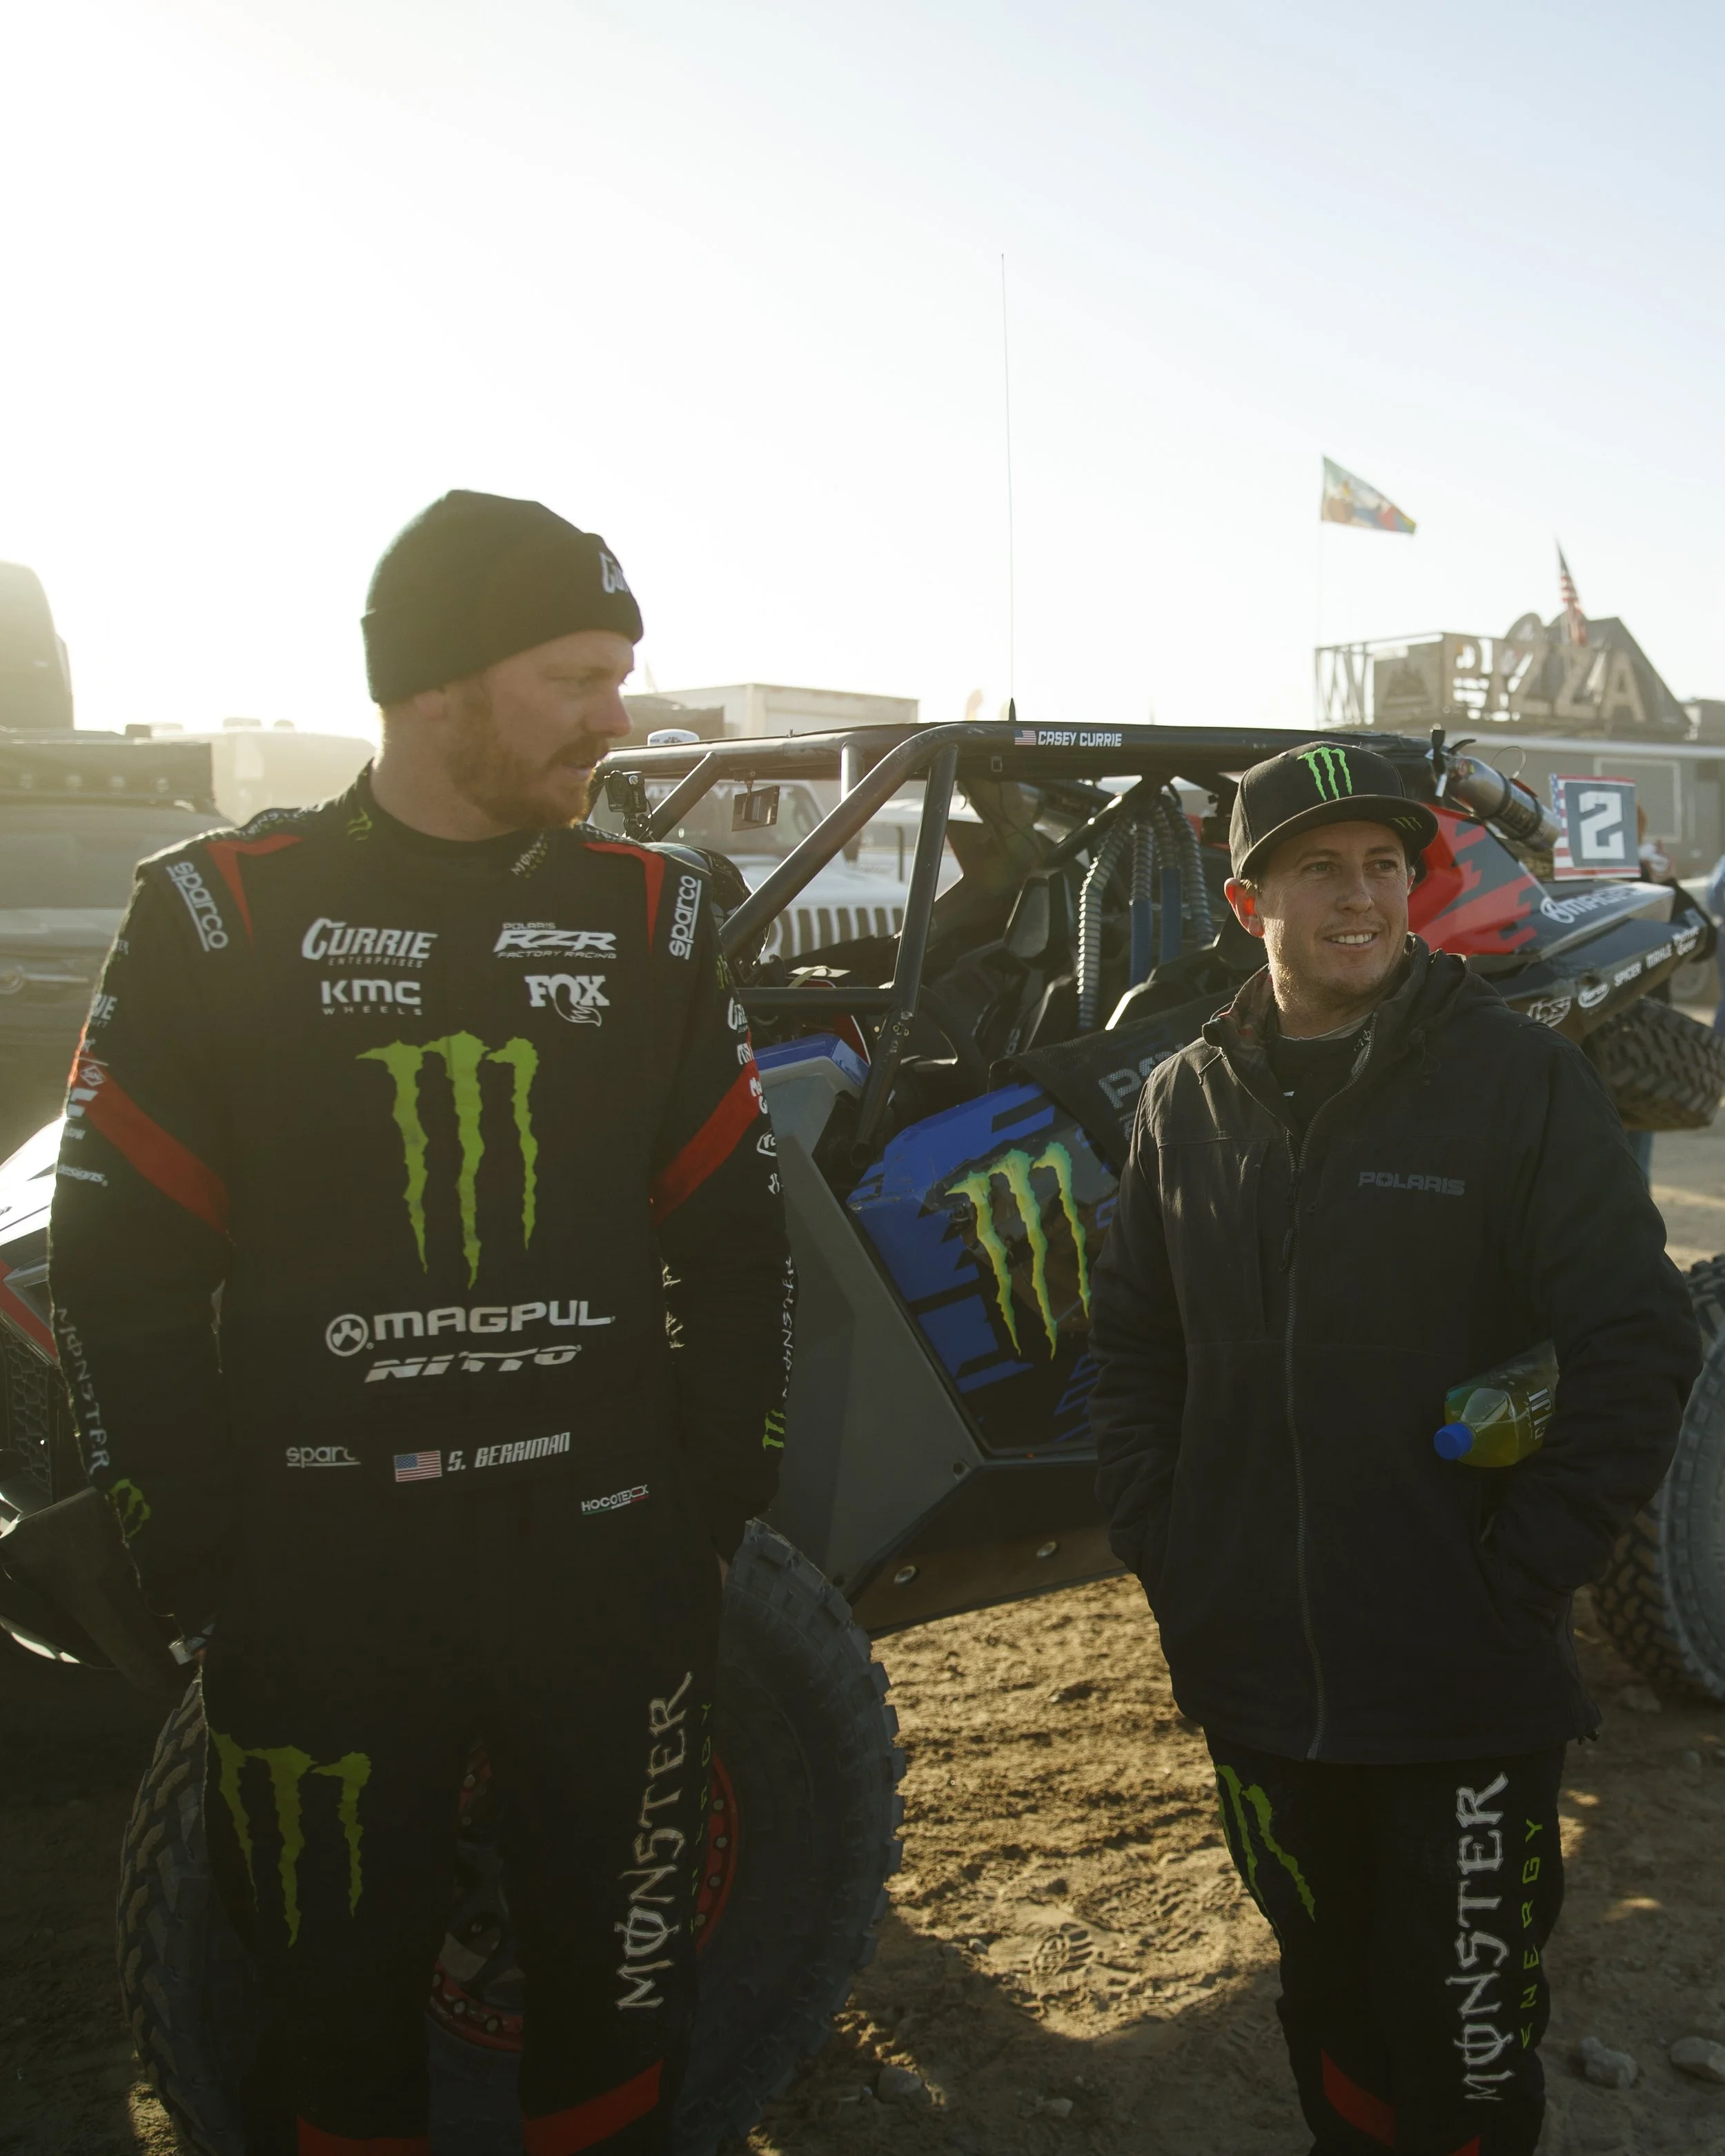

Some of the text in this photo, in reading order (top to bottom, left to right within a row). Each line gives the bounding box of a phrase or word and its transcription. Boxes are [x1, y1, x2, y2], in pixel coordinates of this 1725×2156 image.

[1038, 731, 1123, 748] CASEY CURRIE
[1579, 791, 1625, 860] 2
[166, 861, 228, 951] sparco
[669, 875, 702, 960] sparco
[302, 917, 438, 960] CURRIE
[493, 929, 617, 953] RZR
[497, 950, 617, 959] FACTORY RACING
[328, 956, 424, 969] ENTERPRISES
[321, 978, 422, 1005] KMC
[524, 973, 610, 1022] FOX
[322, 1005, 422, 1016] WHEELS
[1358, 1171, 1466, 1196] POLARIS
[373, 1300, 613, 1341] MAGPUL
[364, 1345, 580, 1383] NITTO
[447, 1450, 466, 1472] S.
[1520, 1819, 1543, 2049] ENERGY
